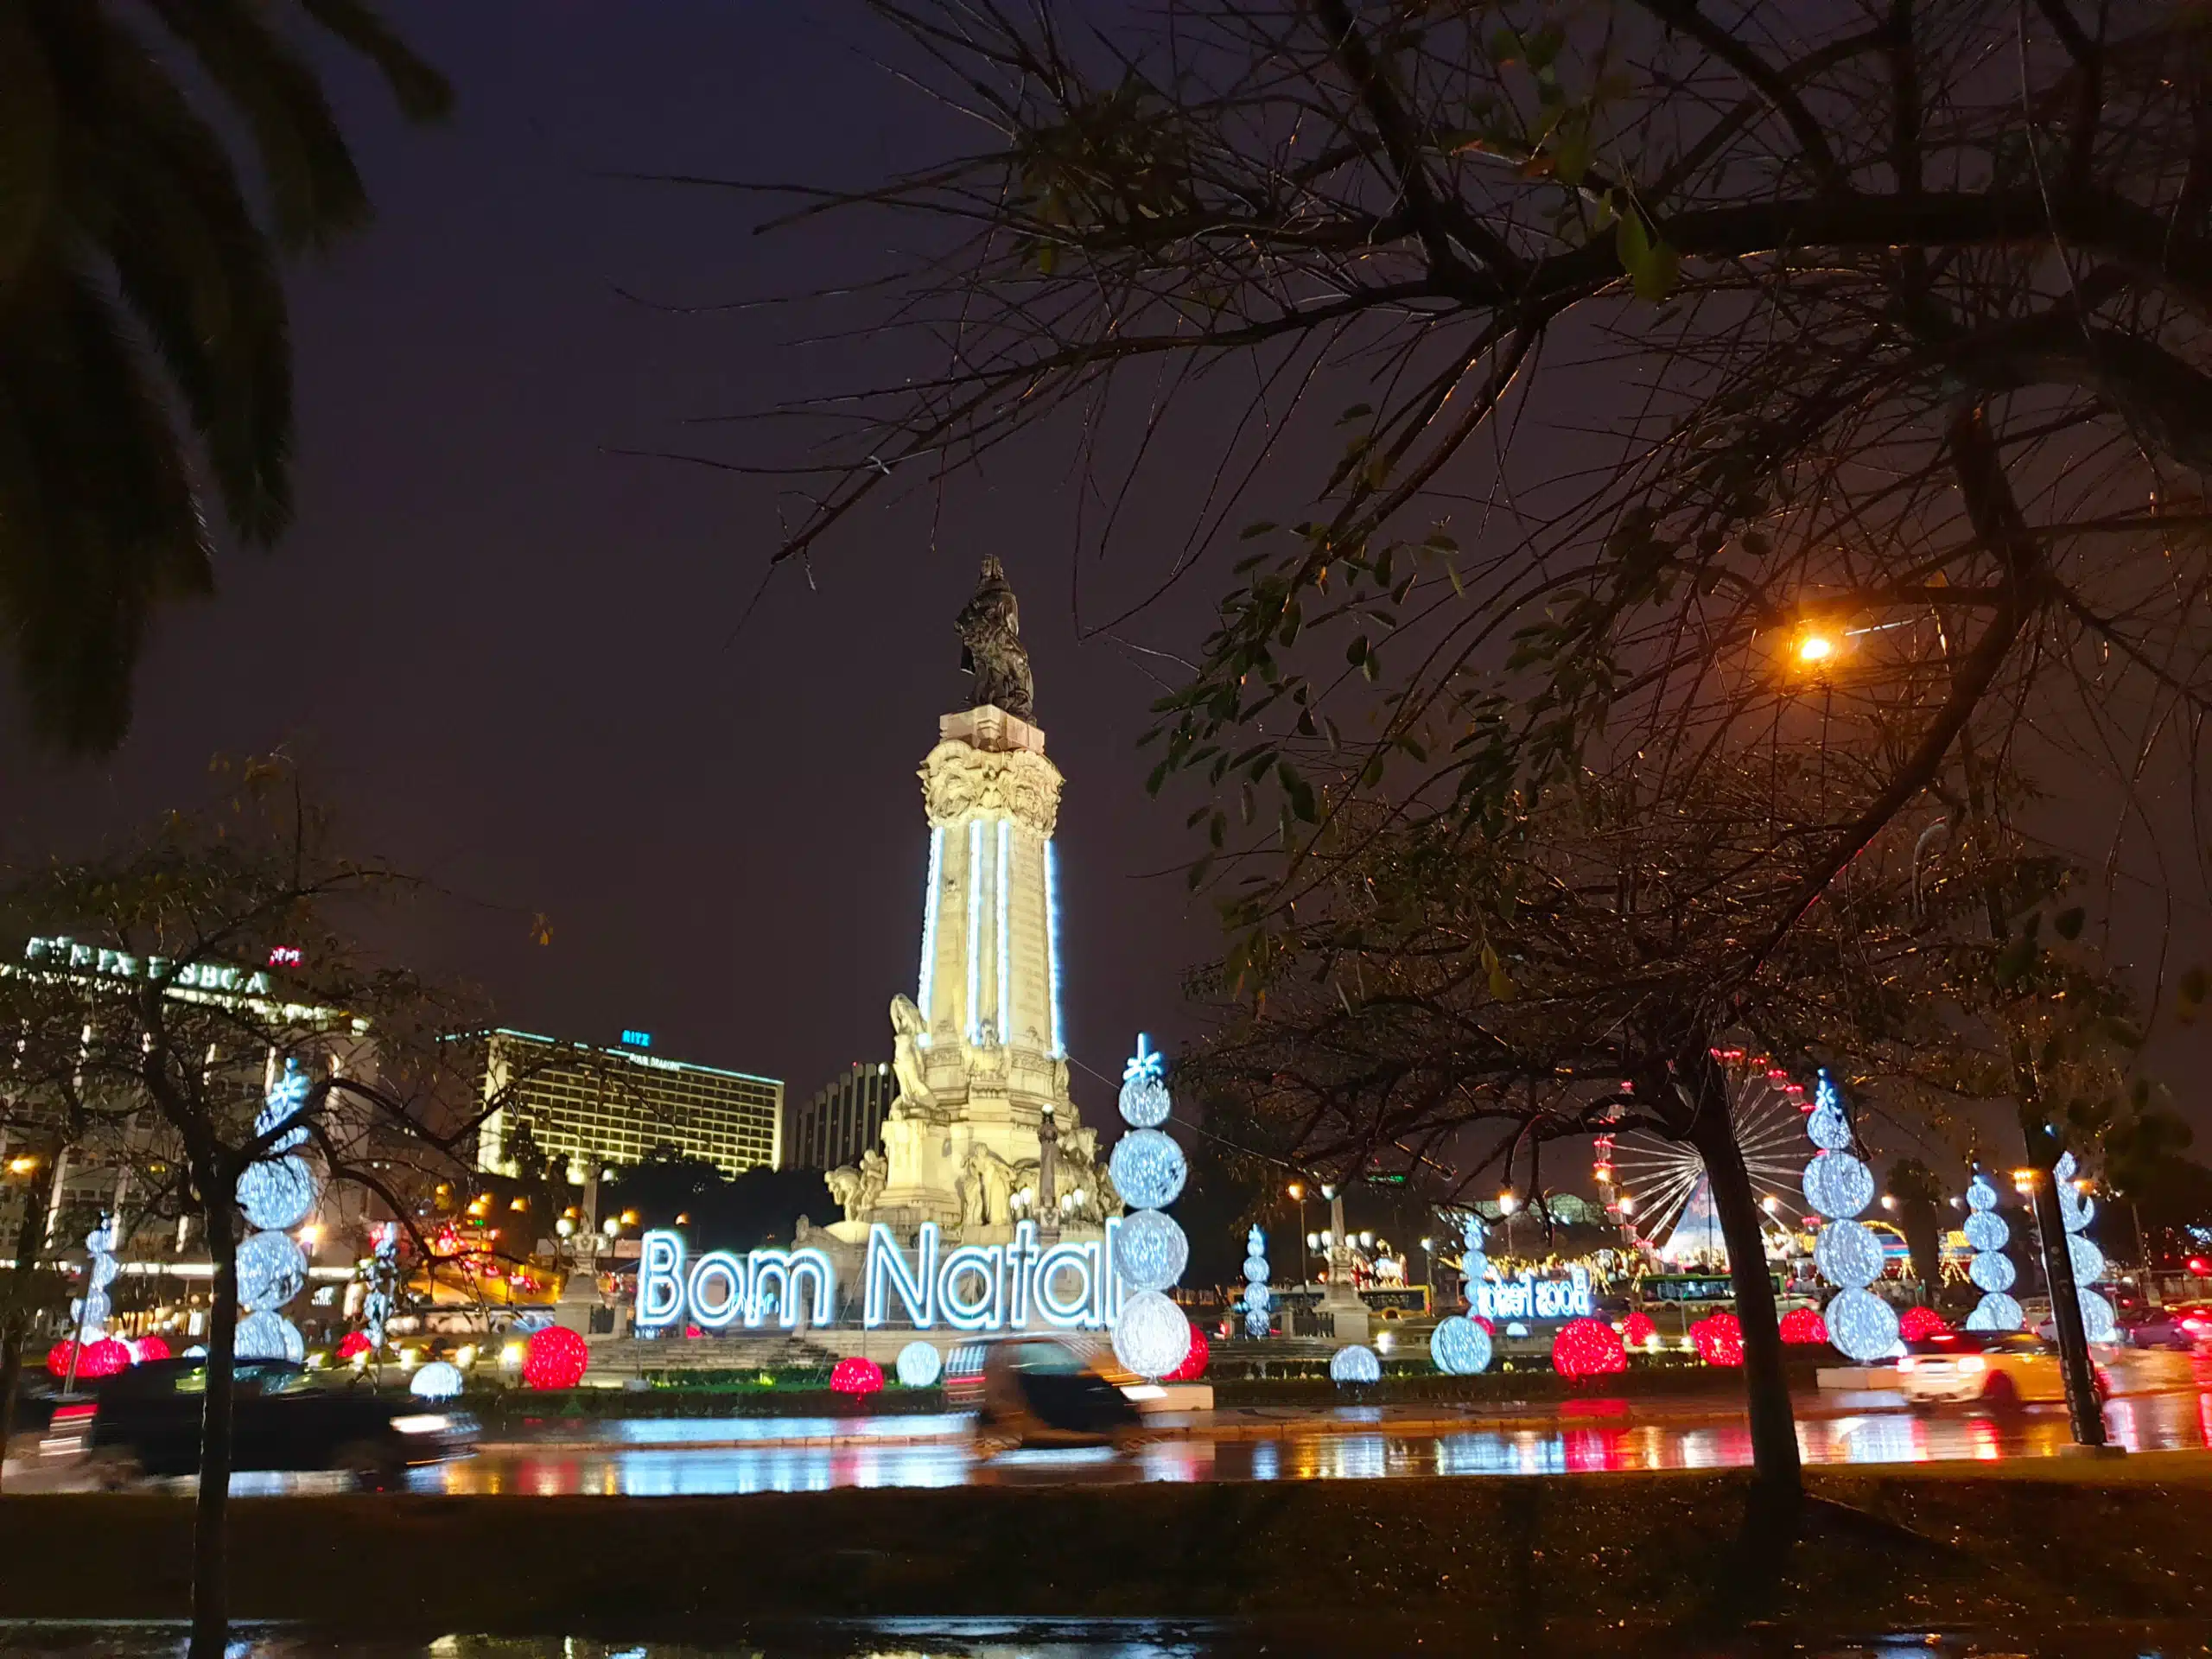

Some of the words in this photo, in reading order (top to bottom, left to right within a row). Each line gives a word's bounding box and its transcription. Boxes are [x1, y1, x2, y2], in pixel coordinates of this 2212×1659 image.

[622, 1029, 650, 1047] RITZ
[636, 1230, 833, 1327] Bom
[864, 1219, 1123, 1330] Natal
